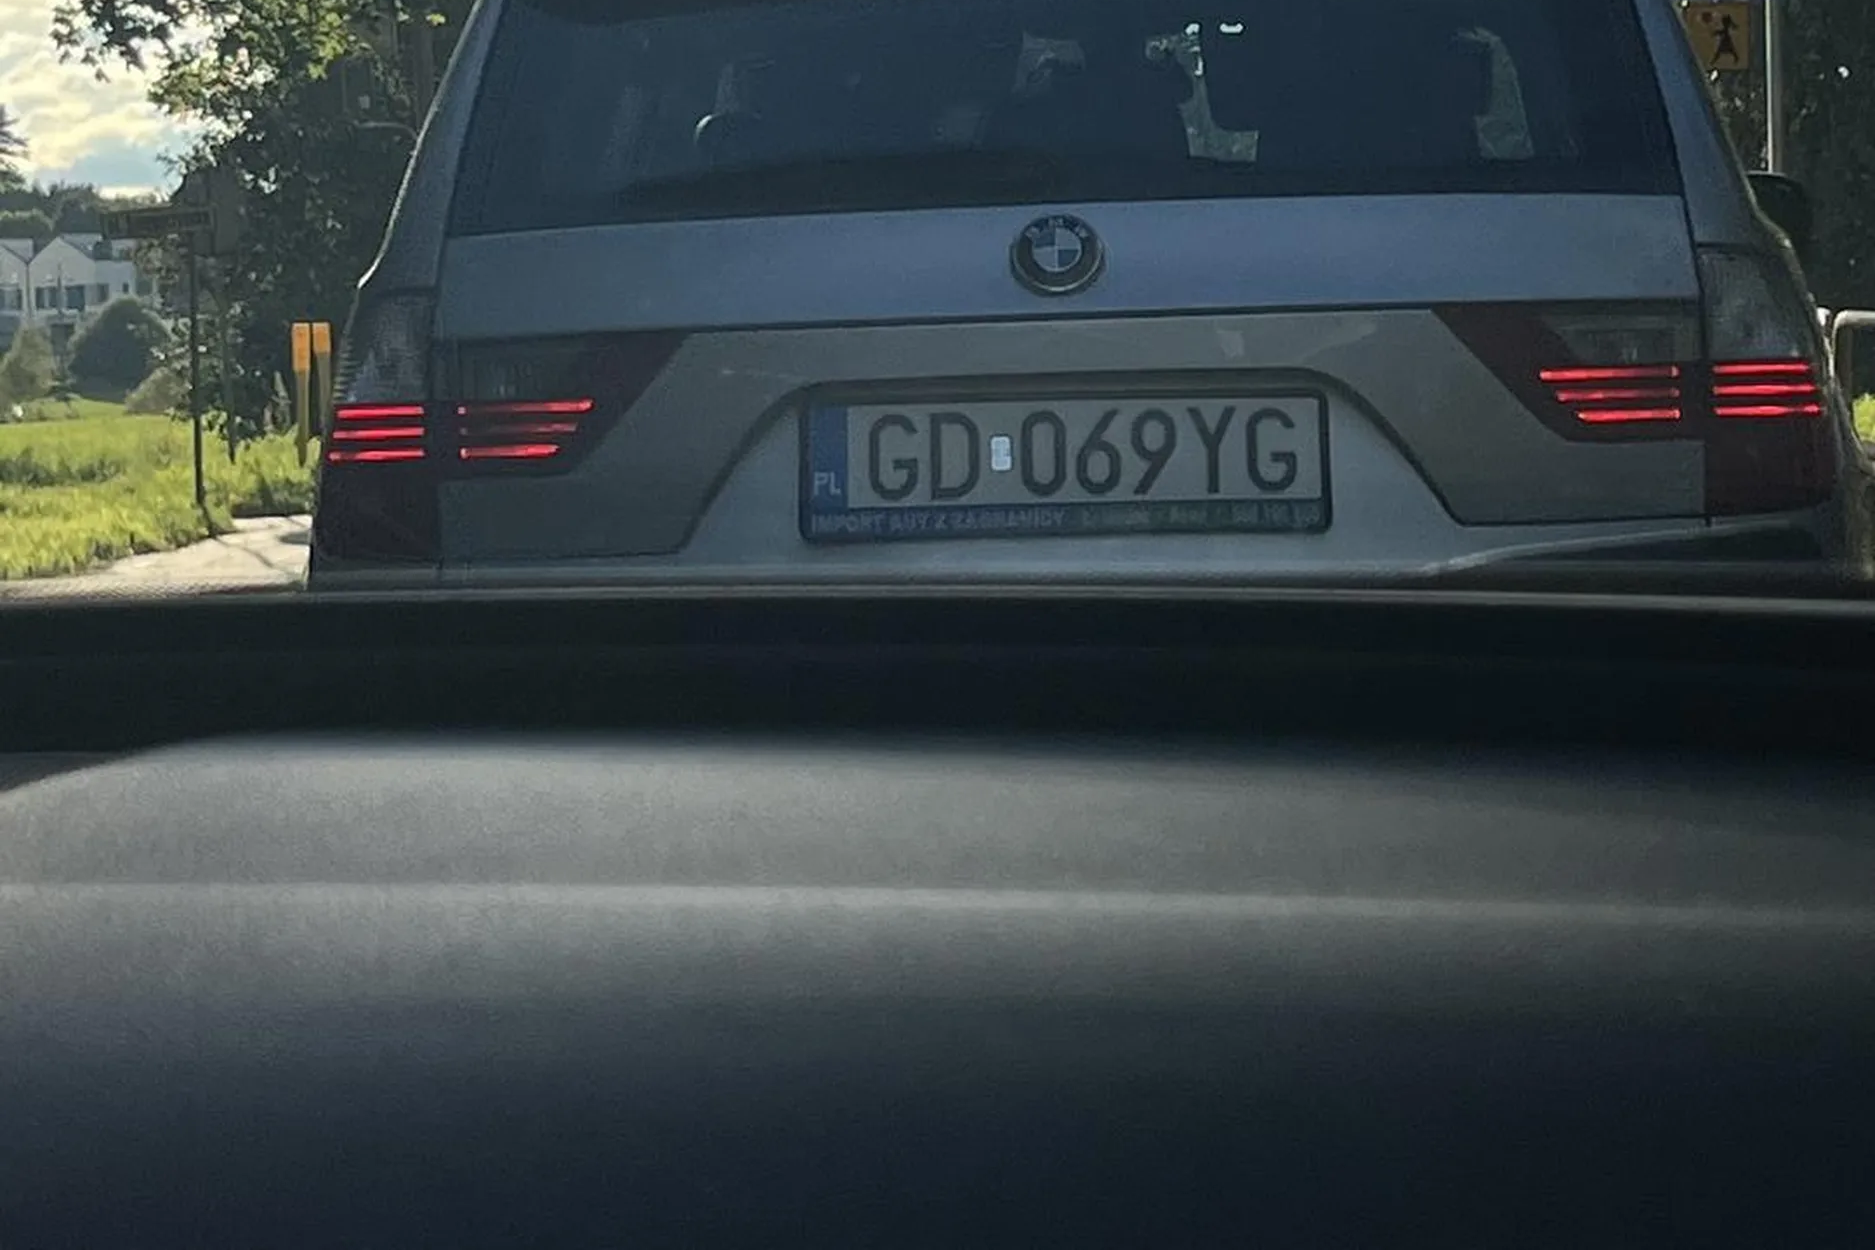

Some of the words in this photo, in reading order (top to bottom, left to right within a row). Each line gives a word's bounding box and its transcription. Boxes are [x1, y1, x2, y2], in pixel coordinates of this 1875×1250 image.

[868, 412, 980, 502] GD
[1020, 405, 1298, 499] 069YG
[813, 470, 842, 497] PL
[811, 513, 886, 535] IMPORT
